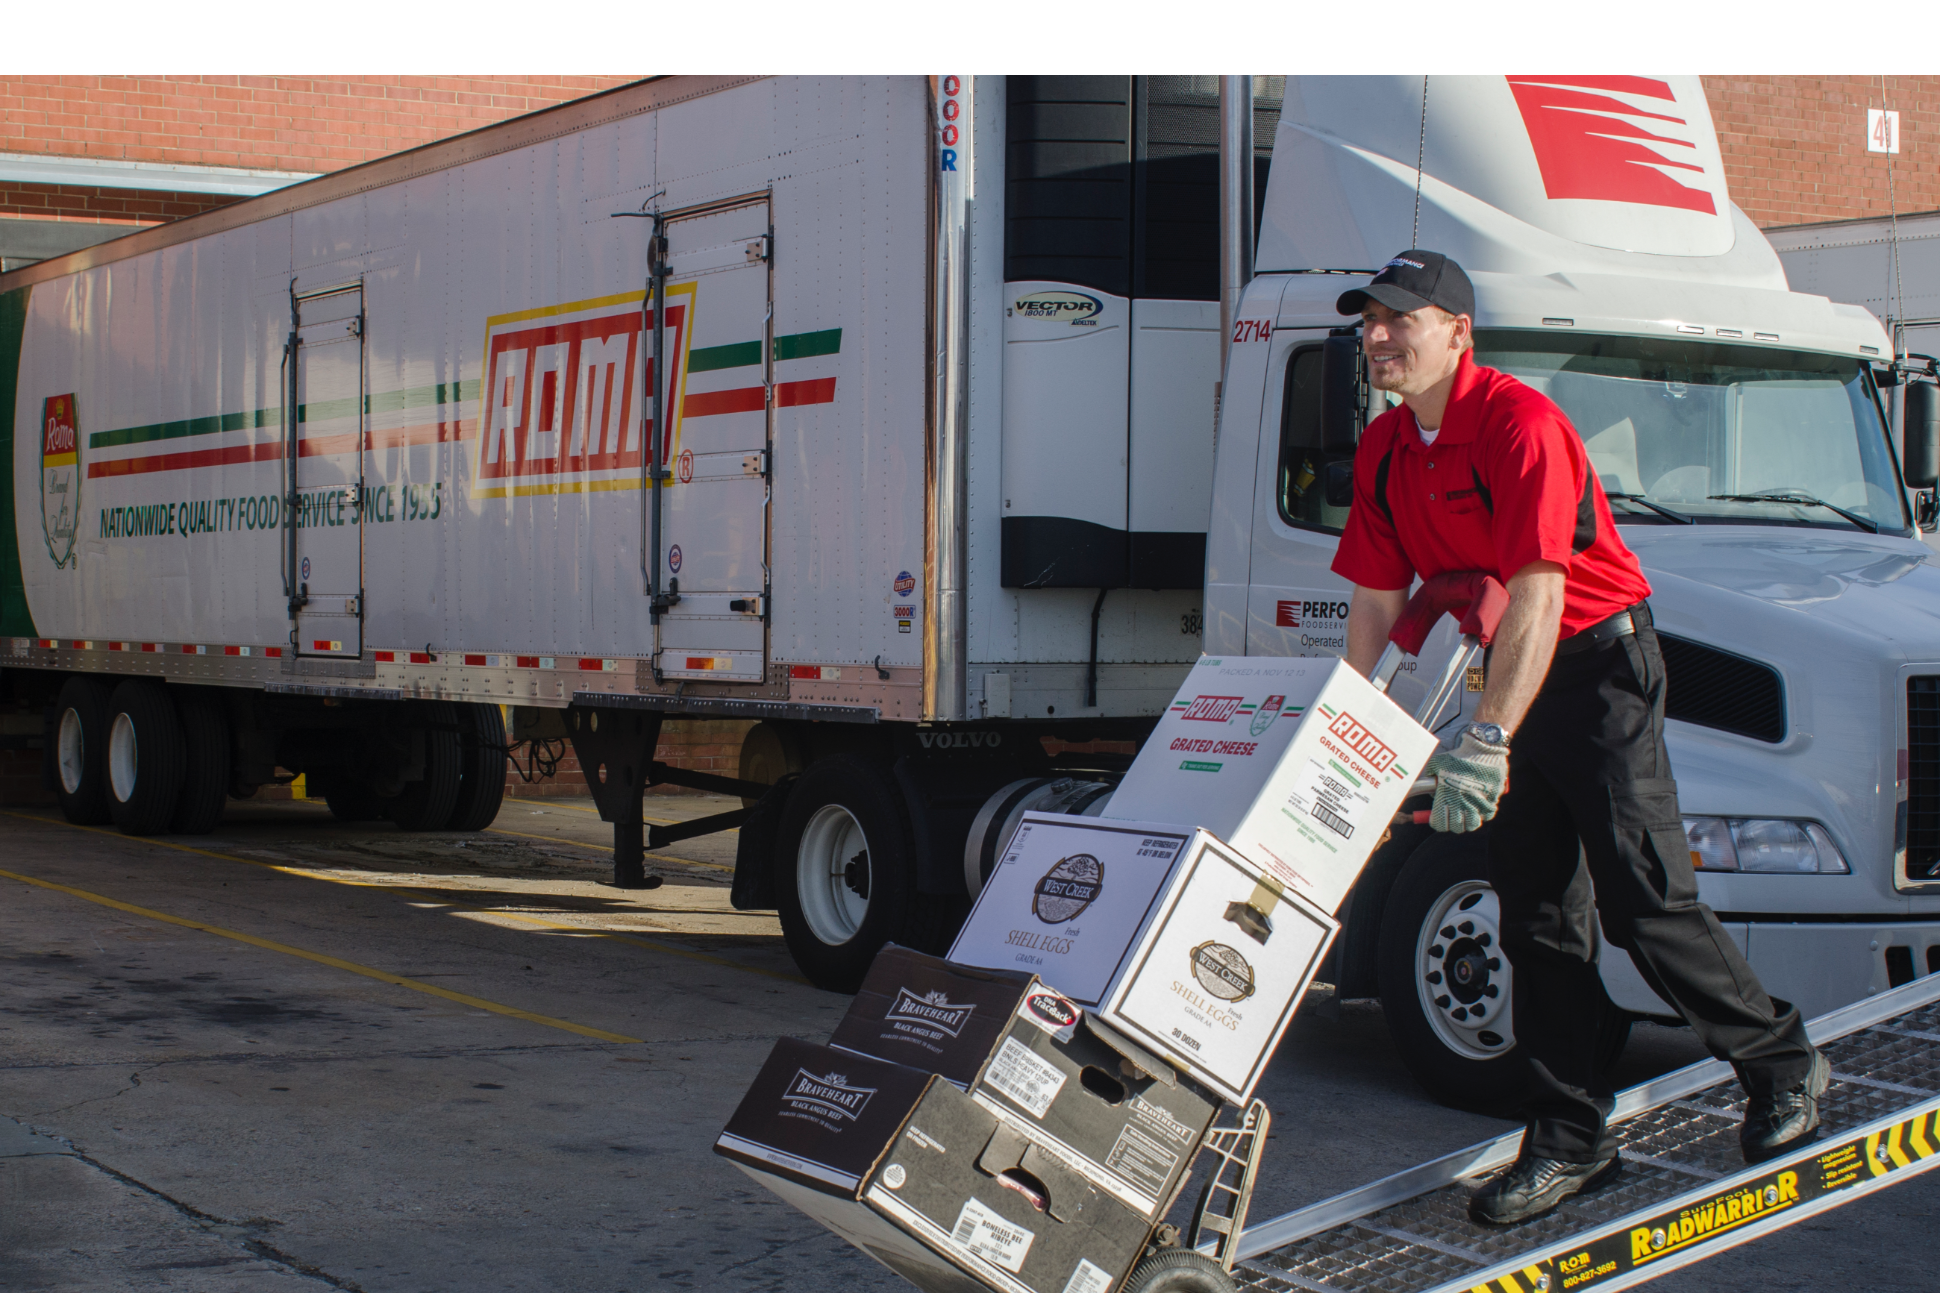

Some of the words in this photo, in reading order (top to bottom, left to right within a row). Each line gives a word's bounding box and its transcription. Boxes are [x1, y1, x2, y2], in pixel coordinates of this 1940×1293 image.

[1873, 115, 1892, 148] 41
[1016, 301, 1094, 311] VECTOR
[1233, 320, 1270, 343] 2714
[484, 318, 682, 470] ROMA
[46, 417, 74, 452] Roma
[100, 503, 176, 538] NATIONWIDE
[178, 498, 236, 539] QUALITY
[238, 495, 280, 531] FOOD
[351, 485, 397, 525] SNCE
[402, 482, 442, 521] 1955
[894, 580, 915, 591] UTILITY
[894, 606, 915, 617] 3000R
[1302, 601, 1349, 620] PERFO
[1301, 633, 1344, 649] Operated
[1398, 661, 1417, 674] oup
[1183, 696, 1243, 722] ROMA
[916, 732, 1001, 748] VOLVO
[1169, 737, 1214, 754] GRATED
[1212, 740, 1259, 756] CHEESE
[1329, 712, 1397, 772] ROMA
[1319, 736, 1350, 763] GRATED
[1350, 761, 1381, 789] CHEESE
[1323, 776, 1349, 797] ROMA
[1043, 879, 1067, 895] WEST
[1065, 882, 1095, 899] CREEK
[1004, 929, 1040, 949] SHELL
[1039, 935, 1075, 954] EGGS
[1064, 927, 1080, 937] Fresh
[1015, 953, 1036, 965] GRADE
[1199, 952, 1222, 974] WEST
[1220, 968, 1248, 992] CREEK
[898, 997, 964, 1025] BRAVEHEART
[1033, 996, 1068, 1025] TraceBack
[1043, 996, 1056, 1007] DNA
[1169, 980, 1205, 1011] SHELL
[1205, 1004, 1239, 1031] EGGS
[1184, 1006, 1205, 1025] GRADE
[1203, 1020, 1212, 1029] AA
[1227, 1007, 1243, 1021] Fresh
[893, 1021, 912, 1032] BLACK
[910, 1026, 930, 1037] ANGUS
[928, 1031, 944, 1040] BEEF
[1171, 1027, 1182, 1038] 30
[1180, 1032, 1202, 1052] DOZEN
[1001, 1050, 1018, 1064] BNLS
[1017, 1060, 1035, 1076] HEAVY
[1005, 1043, 1022, 1057] BEEF
[1021, 1053, 1044, 1074] BRISKET
[795, 1077, 863, 1108] BRAVEHEART
[791, 1100, 809, 1110] BLACK
[808, 1105, 829, 1116] ANGUS
[827, 1110, 844, 1121] BEEF
[1136, 1100, 1188, 1137] BRAVEHEART
[1004, 1116, 1030, 1137] DISTRIBUTED
[1035, 1134, 1060, 1153] BRAVEHEART
[1821, 1145, 1856, 1163] Lightweight
[1826, 1171, 1838, 1179] Slip
[1826, 1172, 1857, 1188] Reversible
[1630, 1170, 1798, 1260] ROADWARRIOR
[1680, 1188, 1749, 1218] SureFoot
[981, 1219, 1011, 1239] BONELESS
[1011, 1233, 1023, 1245] BEE
[990, 1231, 1012, 1247] RIBEYE
[1563, 1261, 1617, 1289] 800-827-3692
